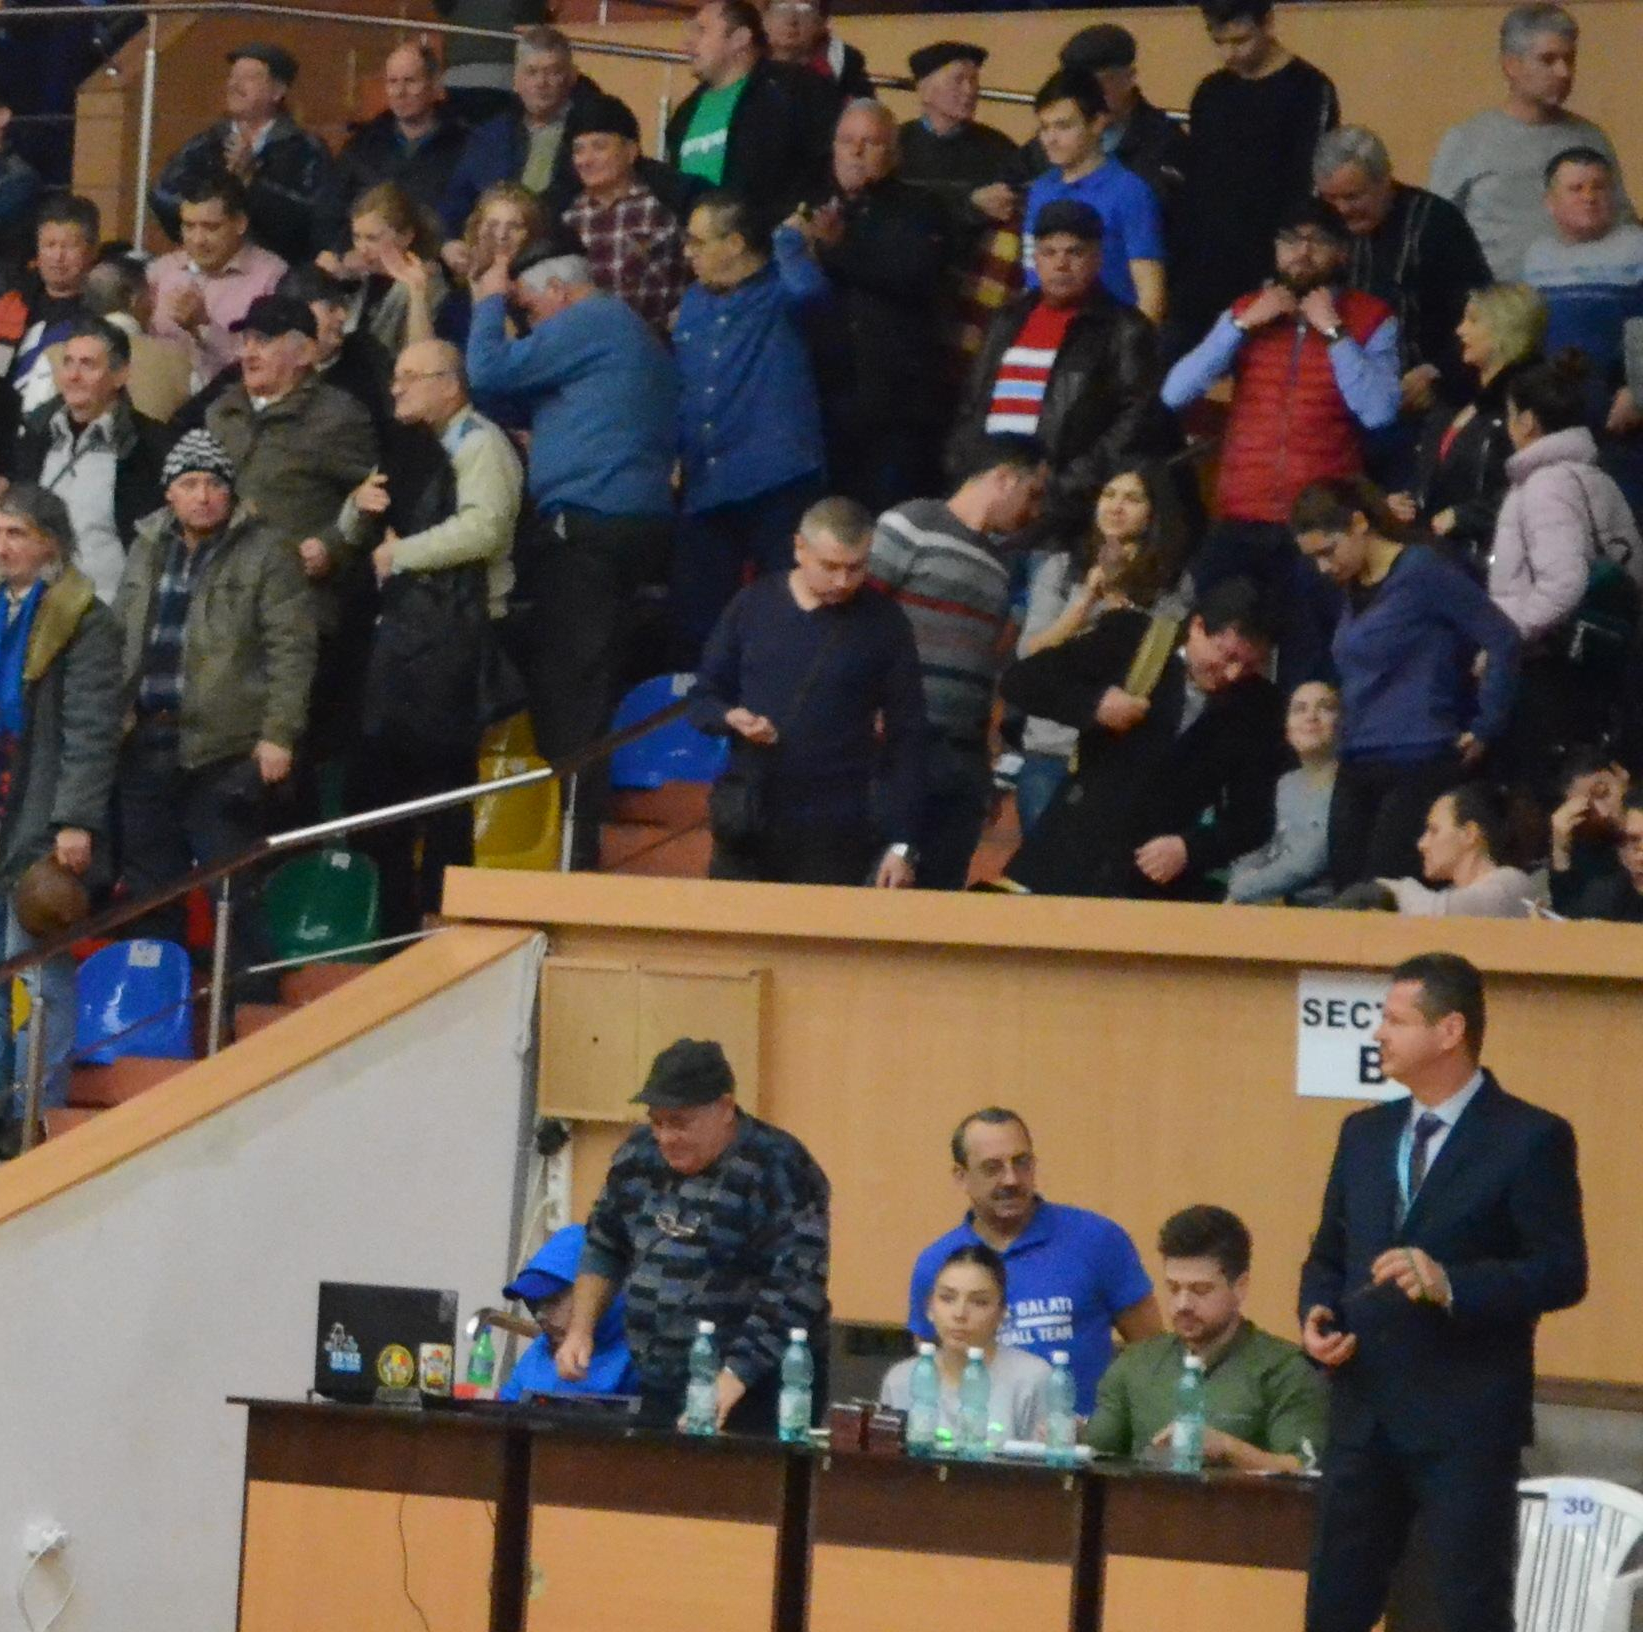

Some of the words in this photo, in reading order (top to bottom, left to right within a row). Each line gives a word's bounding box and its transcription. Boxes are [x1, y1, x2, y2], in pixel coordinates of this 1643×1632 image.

[1301, 998, 1384, 1030] SEC
[1358, 1045, 1387, 1084] B
[1563, 1496, 1595, 1516] 30
